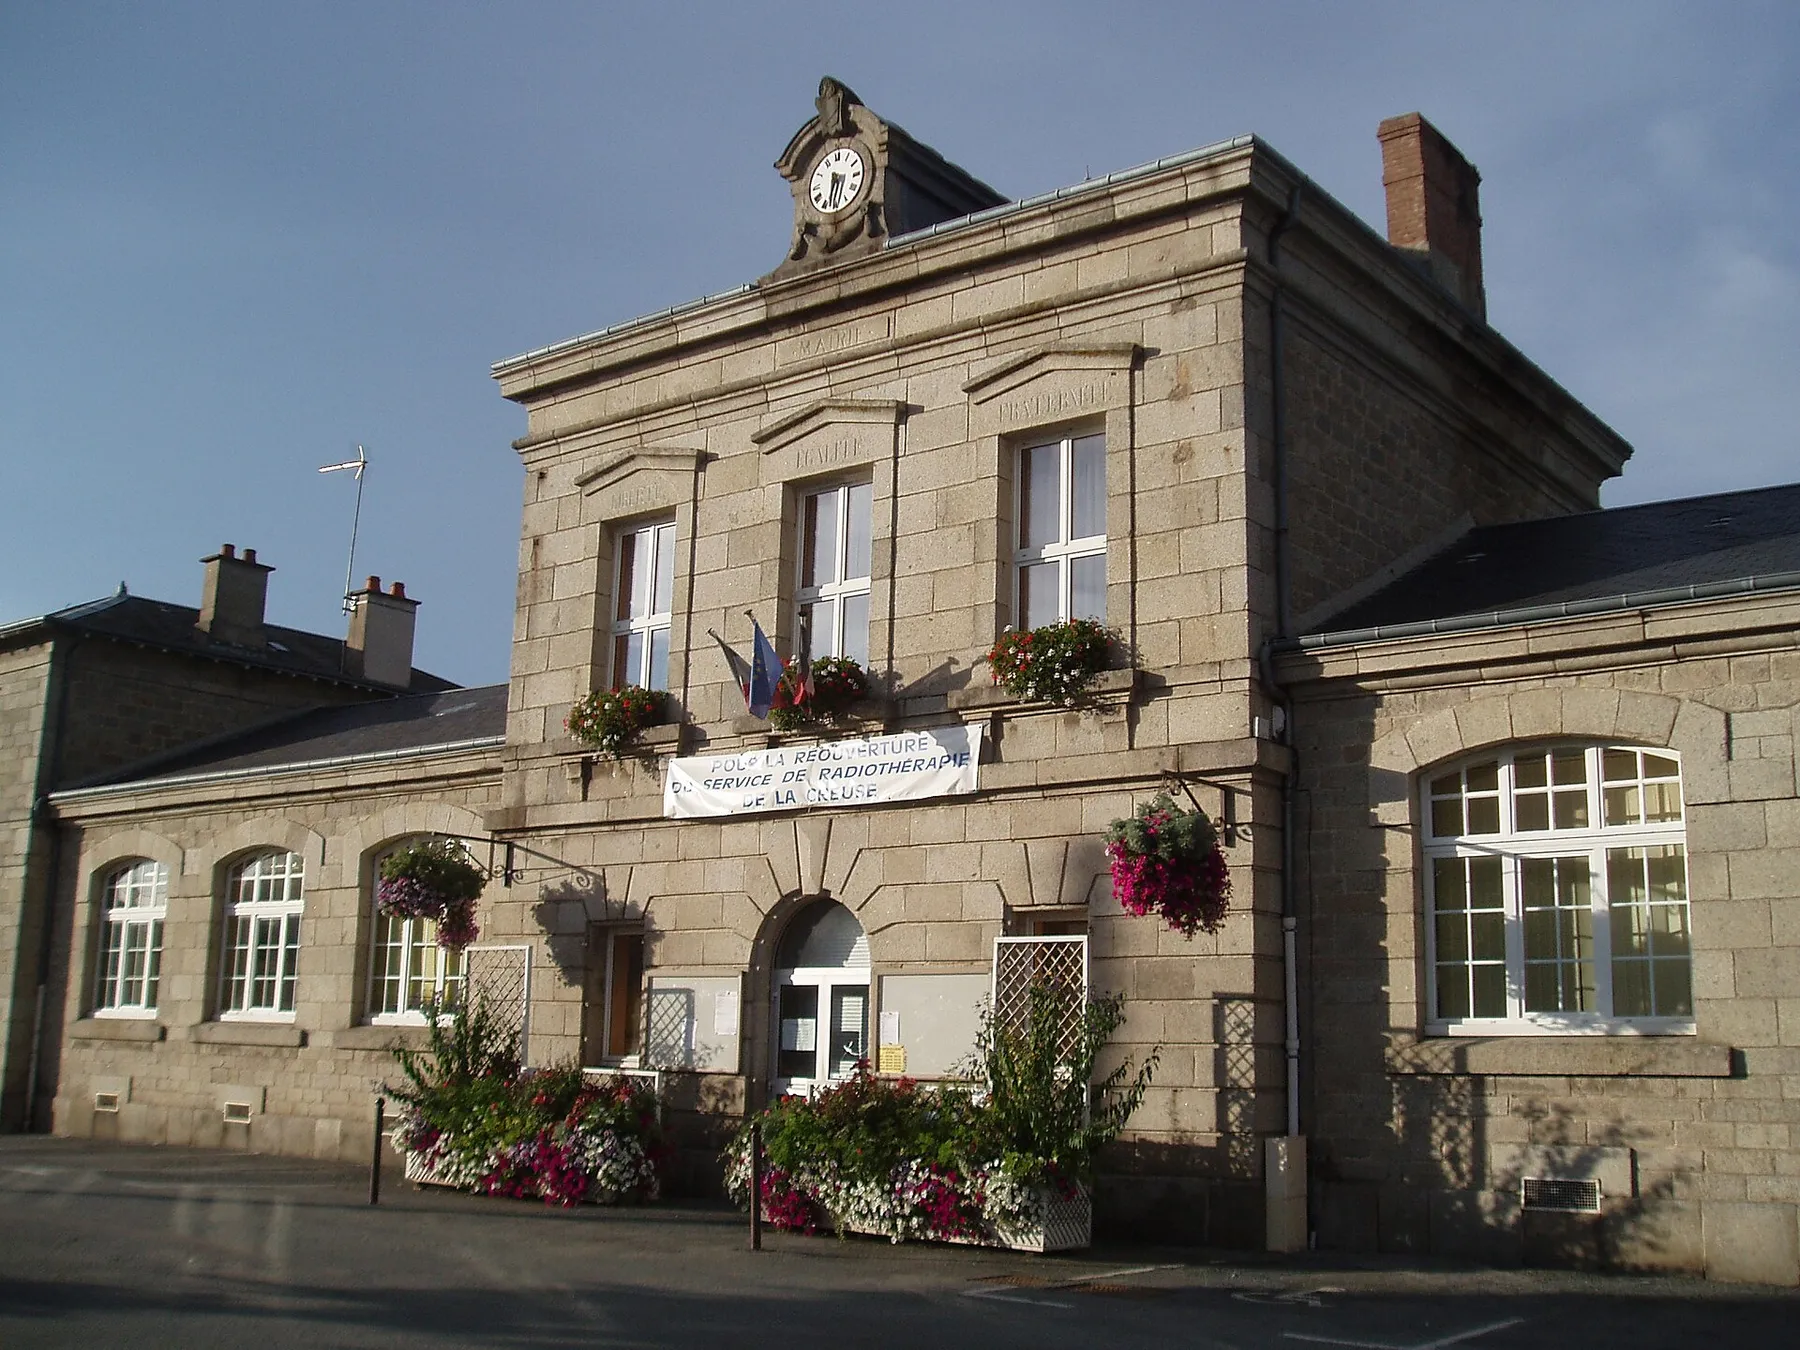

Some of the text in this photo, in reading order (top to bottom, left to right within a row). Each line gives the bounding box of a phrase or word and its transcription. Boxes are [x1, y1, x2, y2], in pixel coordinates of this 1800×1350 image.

[799, 327, 862, 355] MAIRIE
[703, 774, 773, 790] SERVICE
[782, 769, 807, 784] DE
[819, 752, 970, 781] RADIOTHÉRAPIE
[765, 753, 785, 768] LA
[743, 783, 877, 808] DE LA CREUSE
